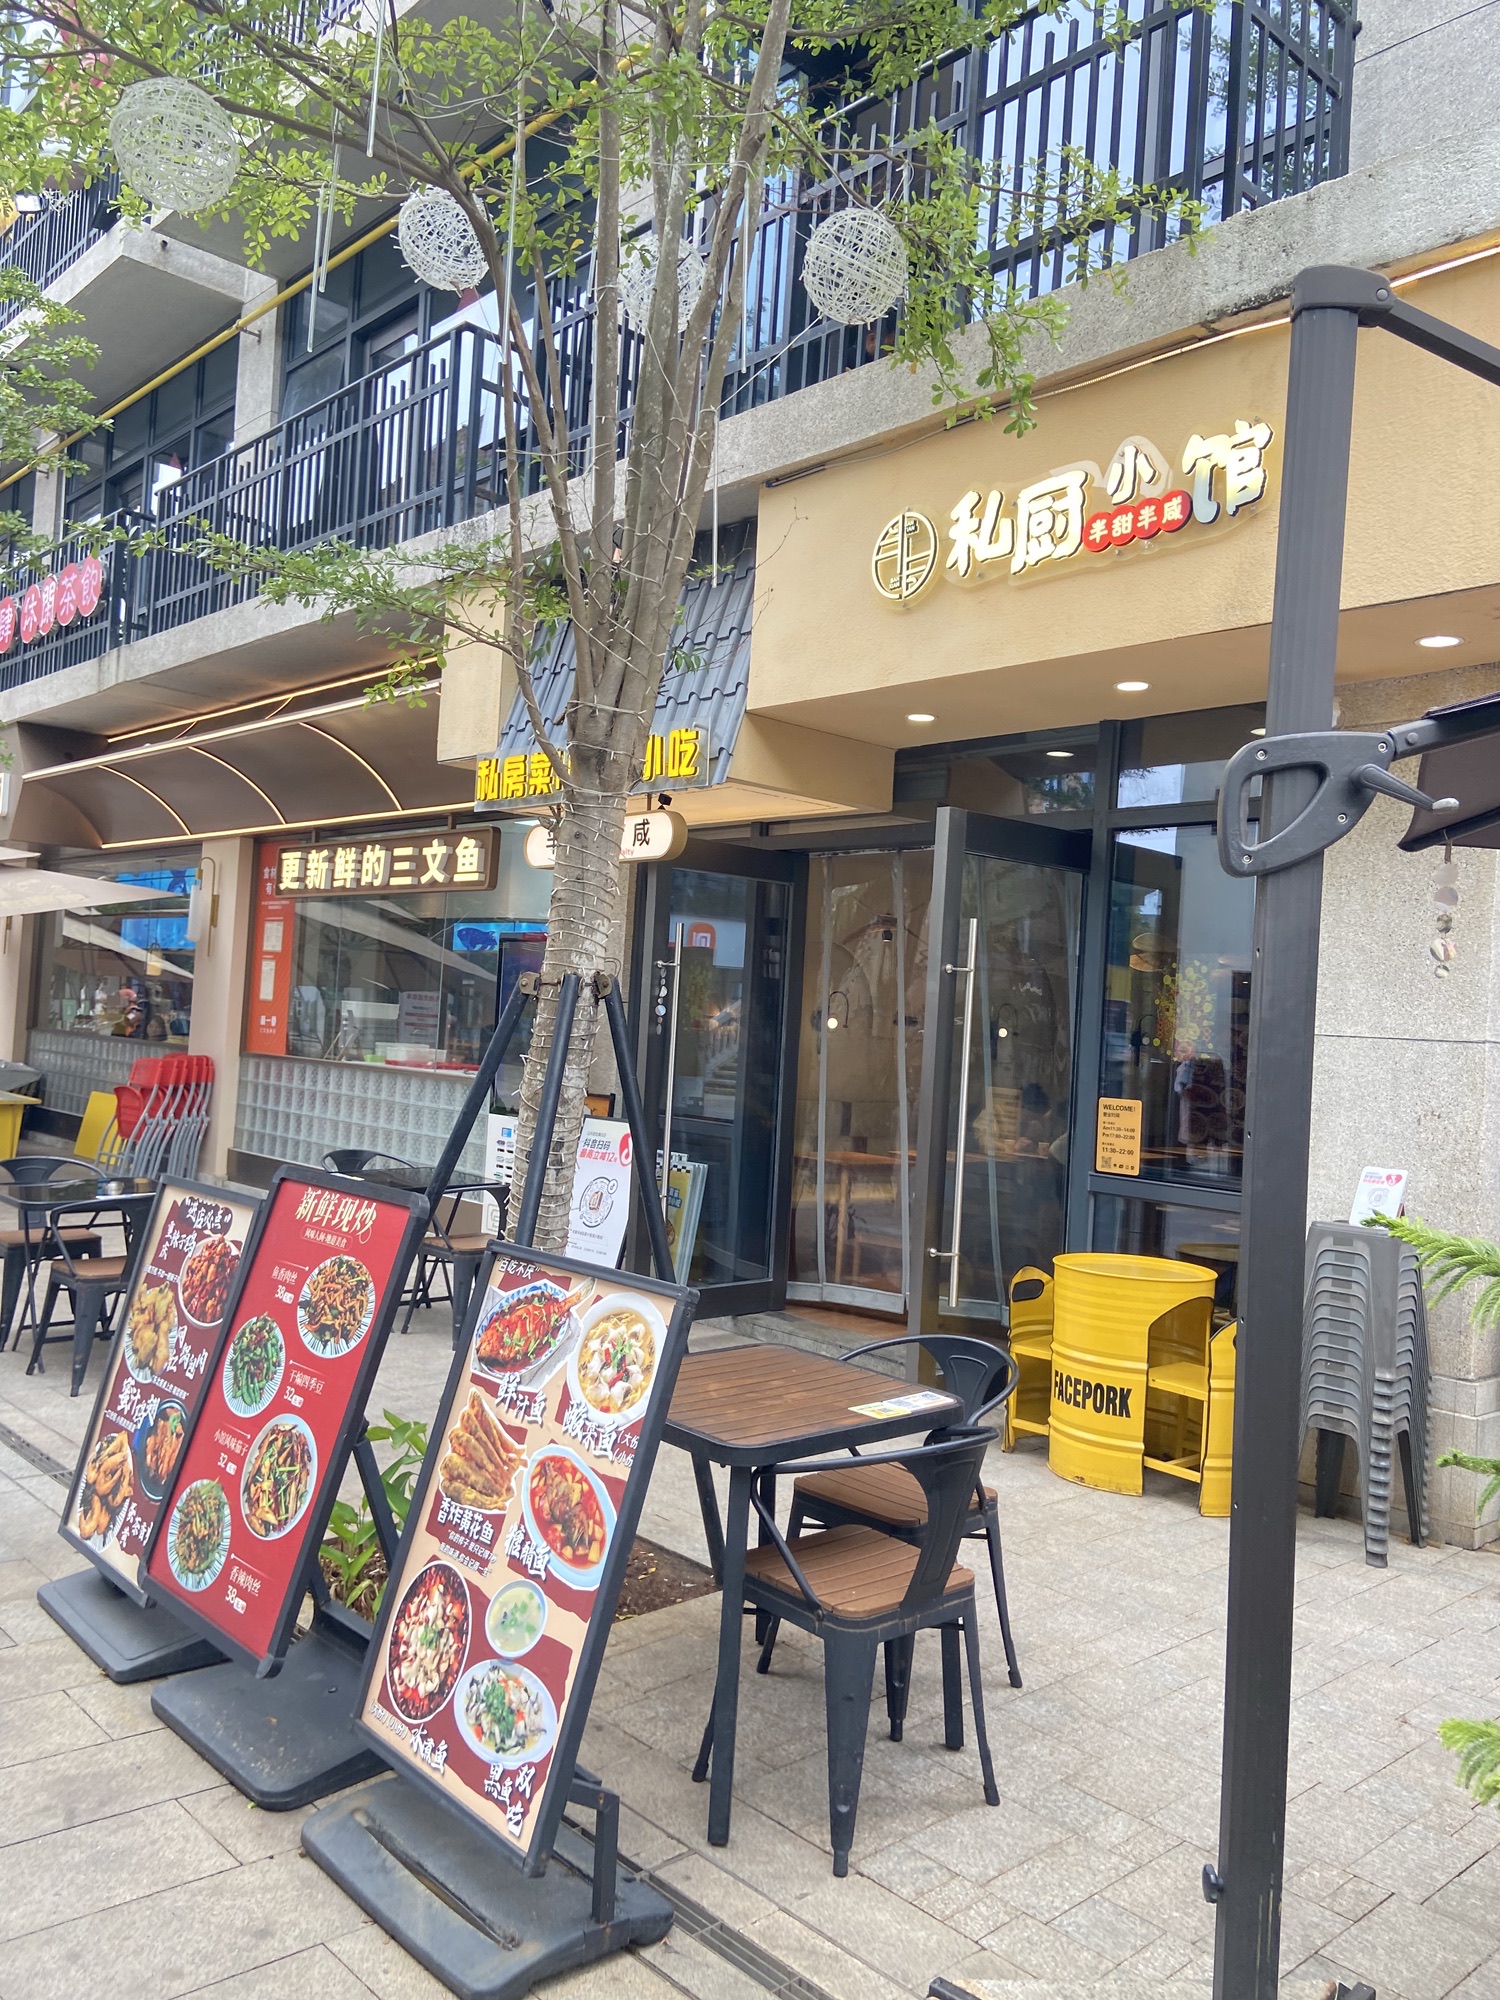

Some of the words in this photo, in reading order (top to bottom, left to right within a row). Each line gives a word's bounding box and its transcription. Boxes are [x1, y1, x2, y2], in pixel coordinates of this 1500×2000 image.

[945, 418, 1275, 577] 私厨小馆
[1087, 494, 1186, 543] 半甜半咸
[643, 728, 701, 782] 小吃
[279, 836, 486, 890] 更新鲜的三文鱼
[1102, 1104, 1136, 1113] WELCOME!
[582, 1138, 612, 1151] 抖音扫码
[295, 1186, 377, 1237] 新鲜现炒
[271, 1265, 298, 1286] 鱼香肉丝
[275, 1285, 285, 1301] 38
[283, 1385, 295, 1401] 32
[1053, 1369, 1133, 1418] FACEPORK
[562, 1400, 618, 1462] 酸菜鱼
[217, 1452, 229, 1468] 32
[437, 1497, 495, 1545] 香炸黄花鱼
[225, 1585, 238, 1604] 38
[229, 1565, 262, 1597] 香辣肉丝
[410, 1723, 448, 1774] 水煮鱼
